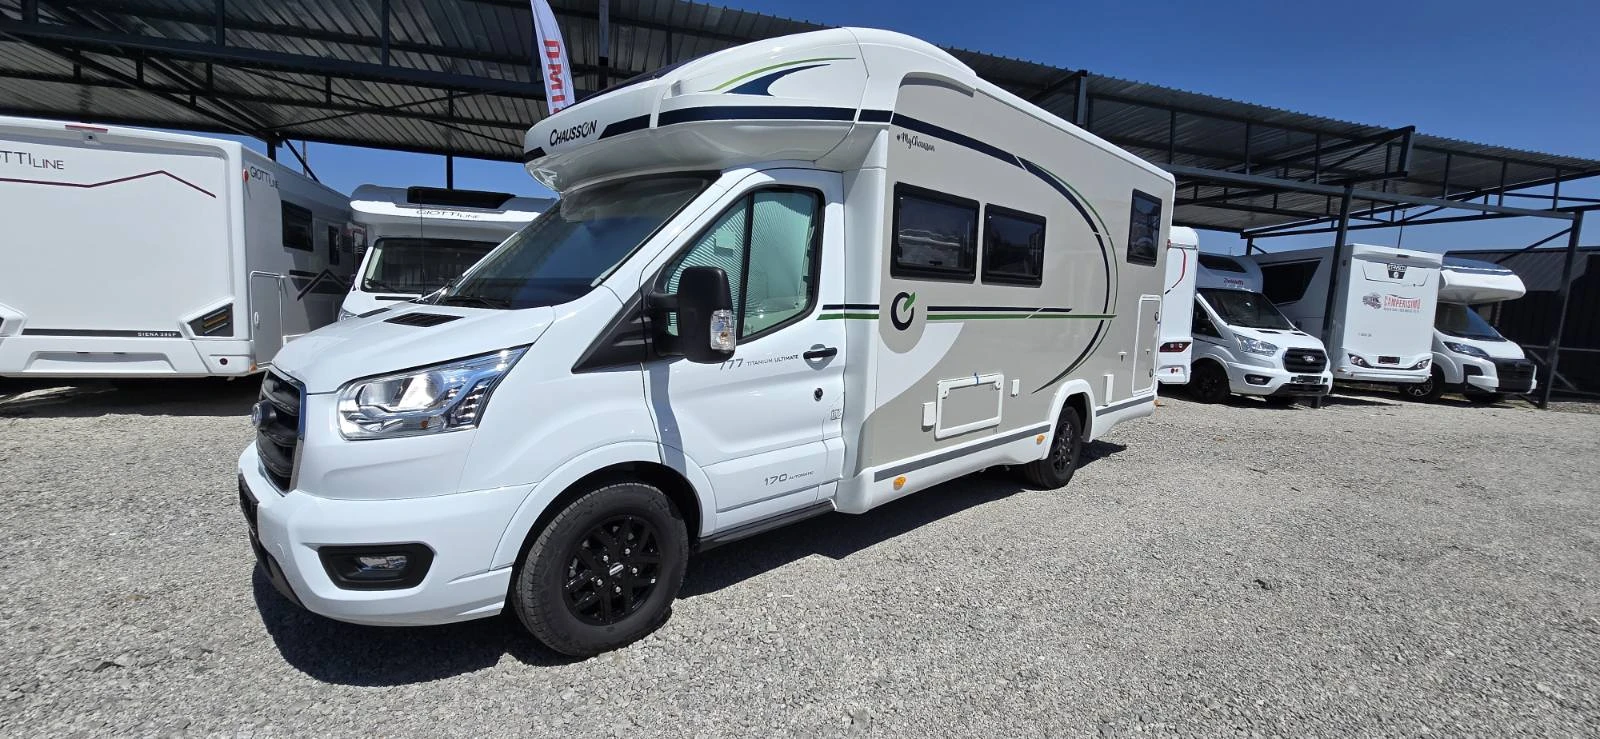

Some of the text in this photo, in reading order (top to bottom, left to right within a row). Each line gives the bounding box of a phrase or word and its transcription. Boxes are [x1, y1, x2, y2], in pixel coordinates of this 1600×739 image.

[550, 120, 598, 147] CHAUSSON
[774, 354, 799, 363] ULTIMATE
[764, 473, 788, 486] 170
